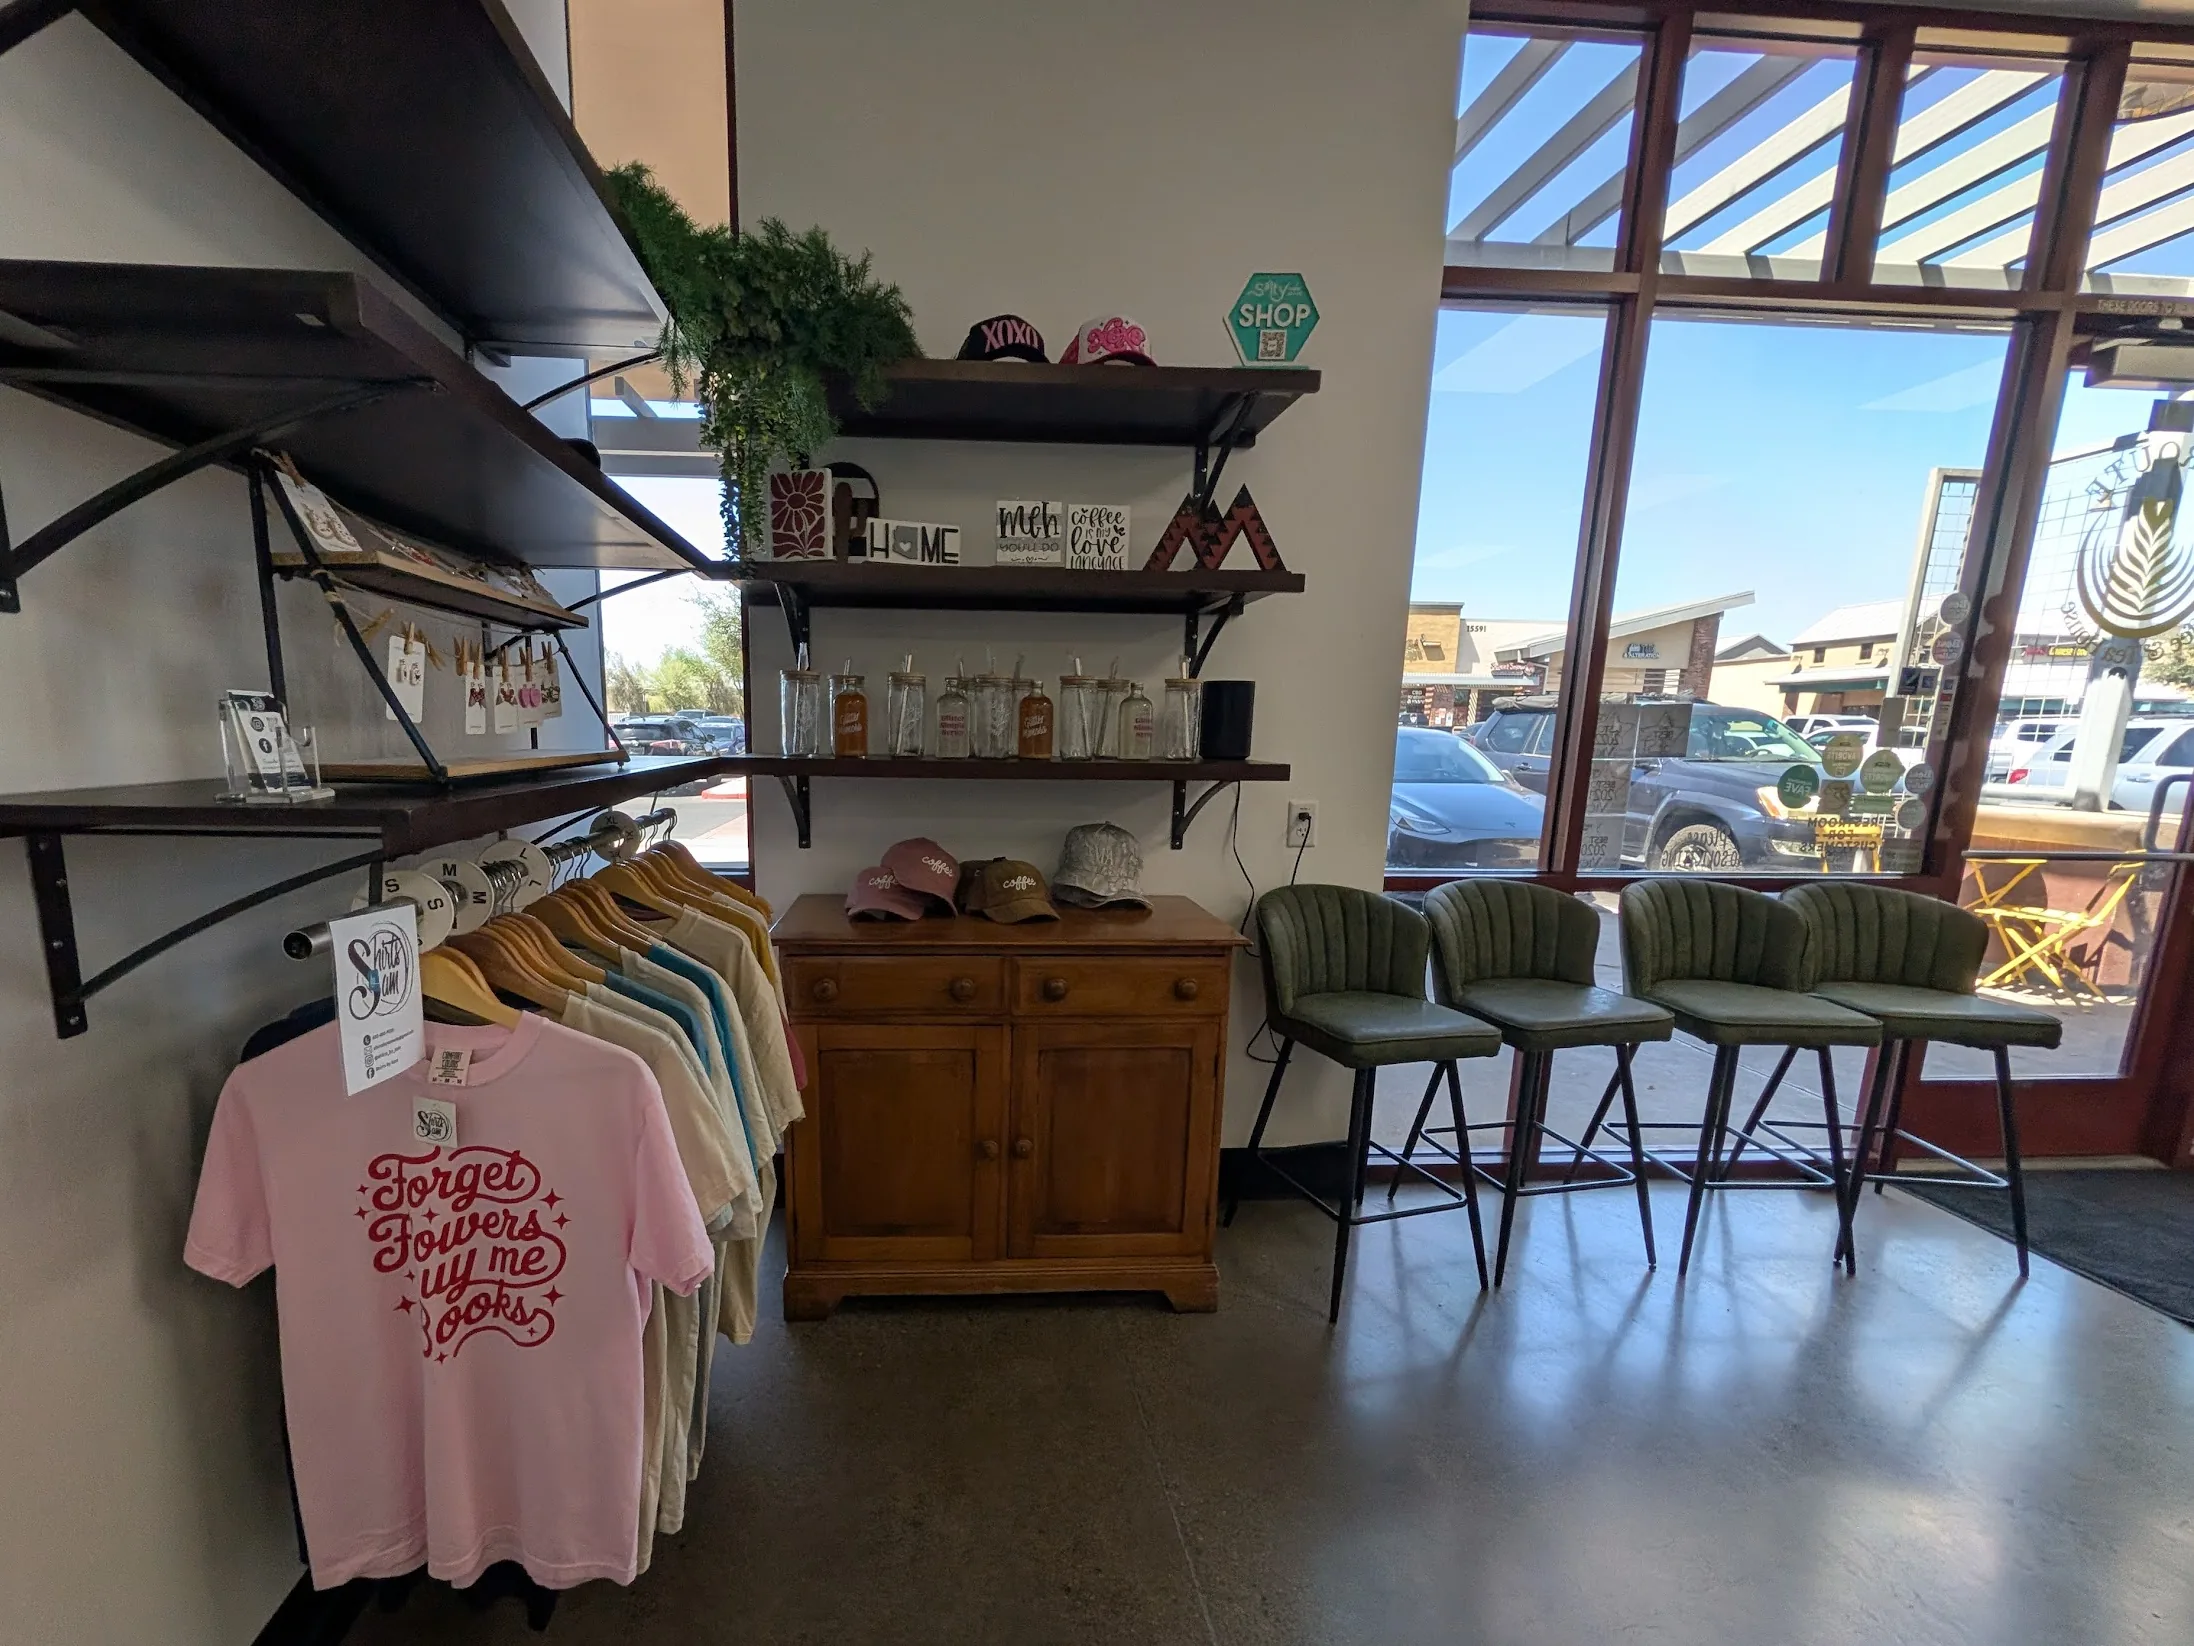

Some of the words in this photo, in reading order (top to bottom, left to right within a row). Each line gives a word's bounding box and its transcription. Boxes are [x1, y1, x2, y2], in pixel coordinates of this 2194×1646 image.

[1238, 303, 1311, 328] SHOP
[981, 319, 1040, 353] XOXO
[1071, 507, 1125, 528] coffee
[869, 521, 959, 564] HME
[1070, 526, 1125, 556] love
[1466, 625, 1487, 633] 15591
[606, 816, 618, 825] XL
[442, 863, 457, 877] M
[921, 855, 953, 877] coffee
[384, 878, 400, 893] S
[1002, 875, 1037, 891] coffee
[427, 897, 444, 911] S
[472, 891, 487, 905] M
[367, 1145, 541, 1212] Forget
[488, 1246, 549, 1277] me
